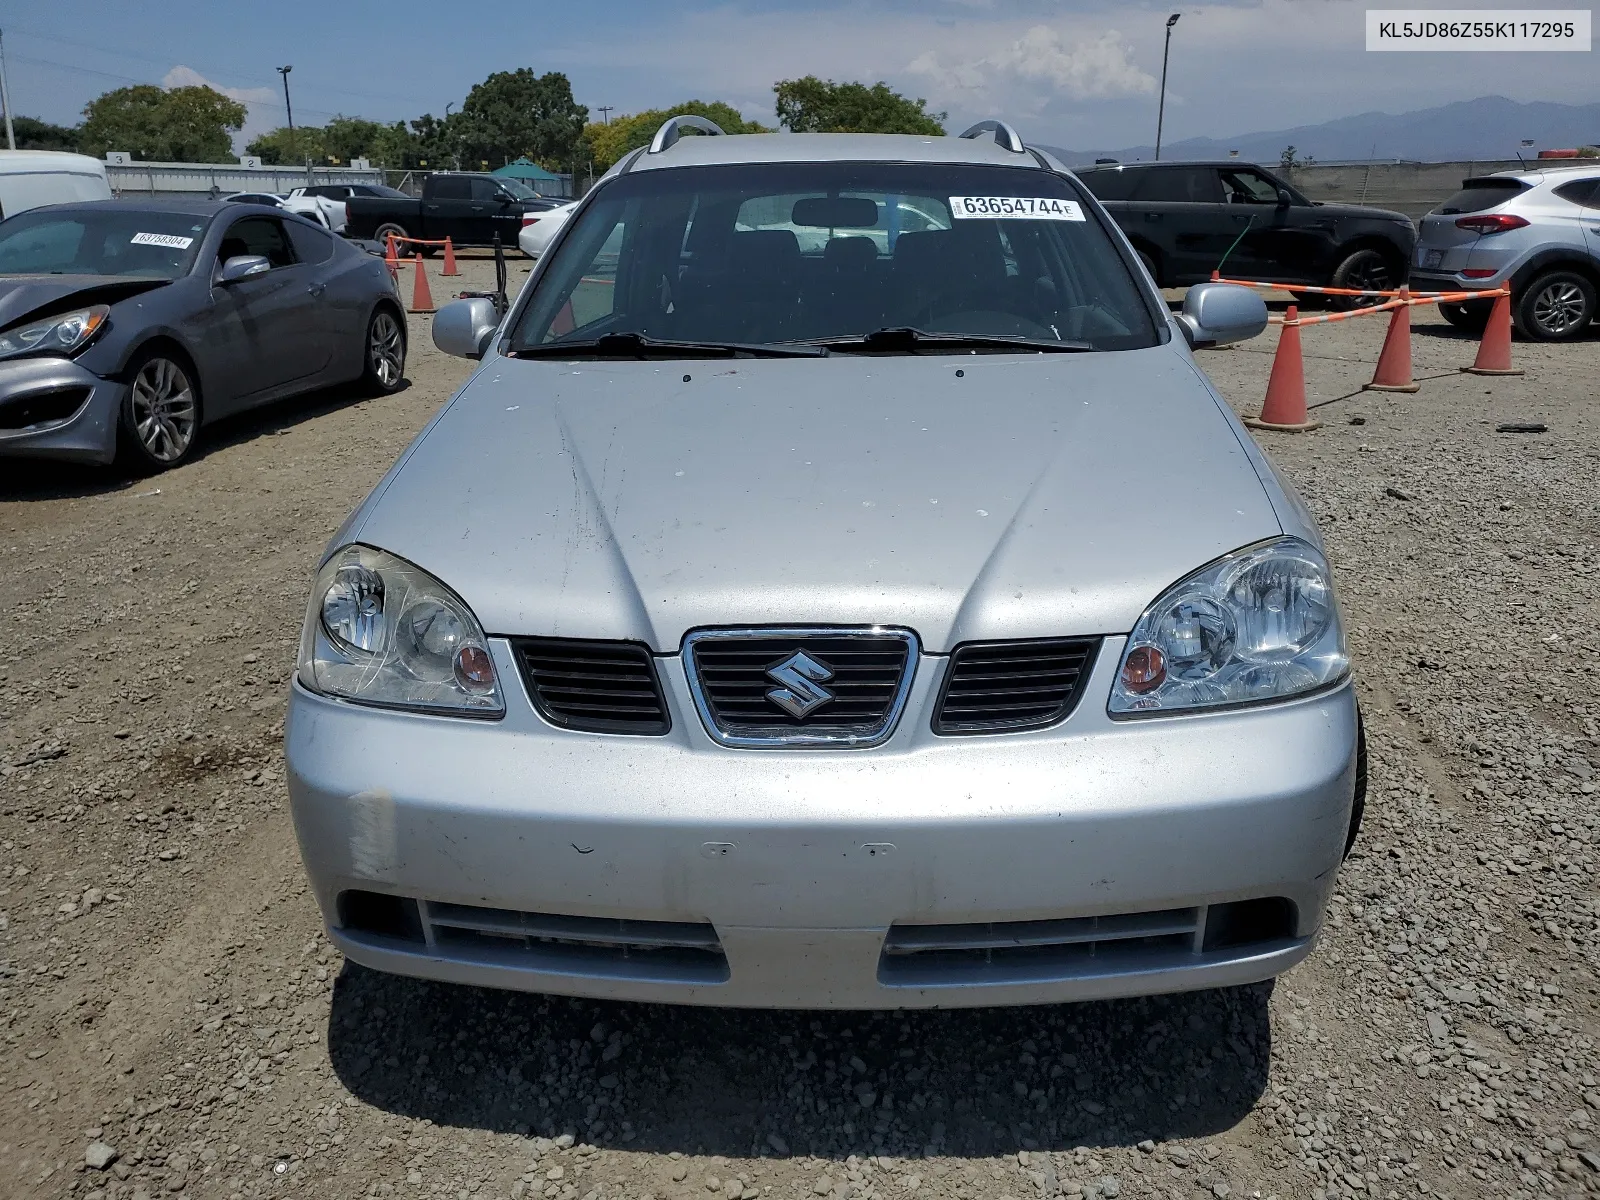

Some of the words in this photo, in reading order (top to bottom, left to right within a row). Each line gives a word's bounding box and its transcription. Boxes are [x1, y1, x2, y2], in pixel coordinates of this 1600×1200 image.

[115, 155, 123, 164] 3
[248, 159, 255, 168] 2
[358, 162, 363, 170] 1
